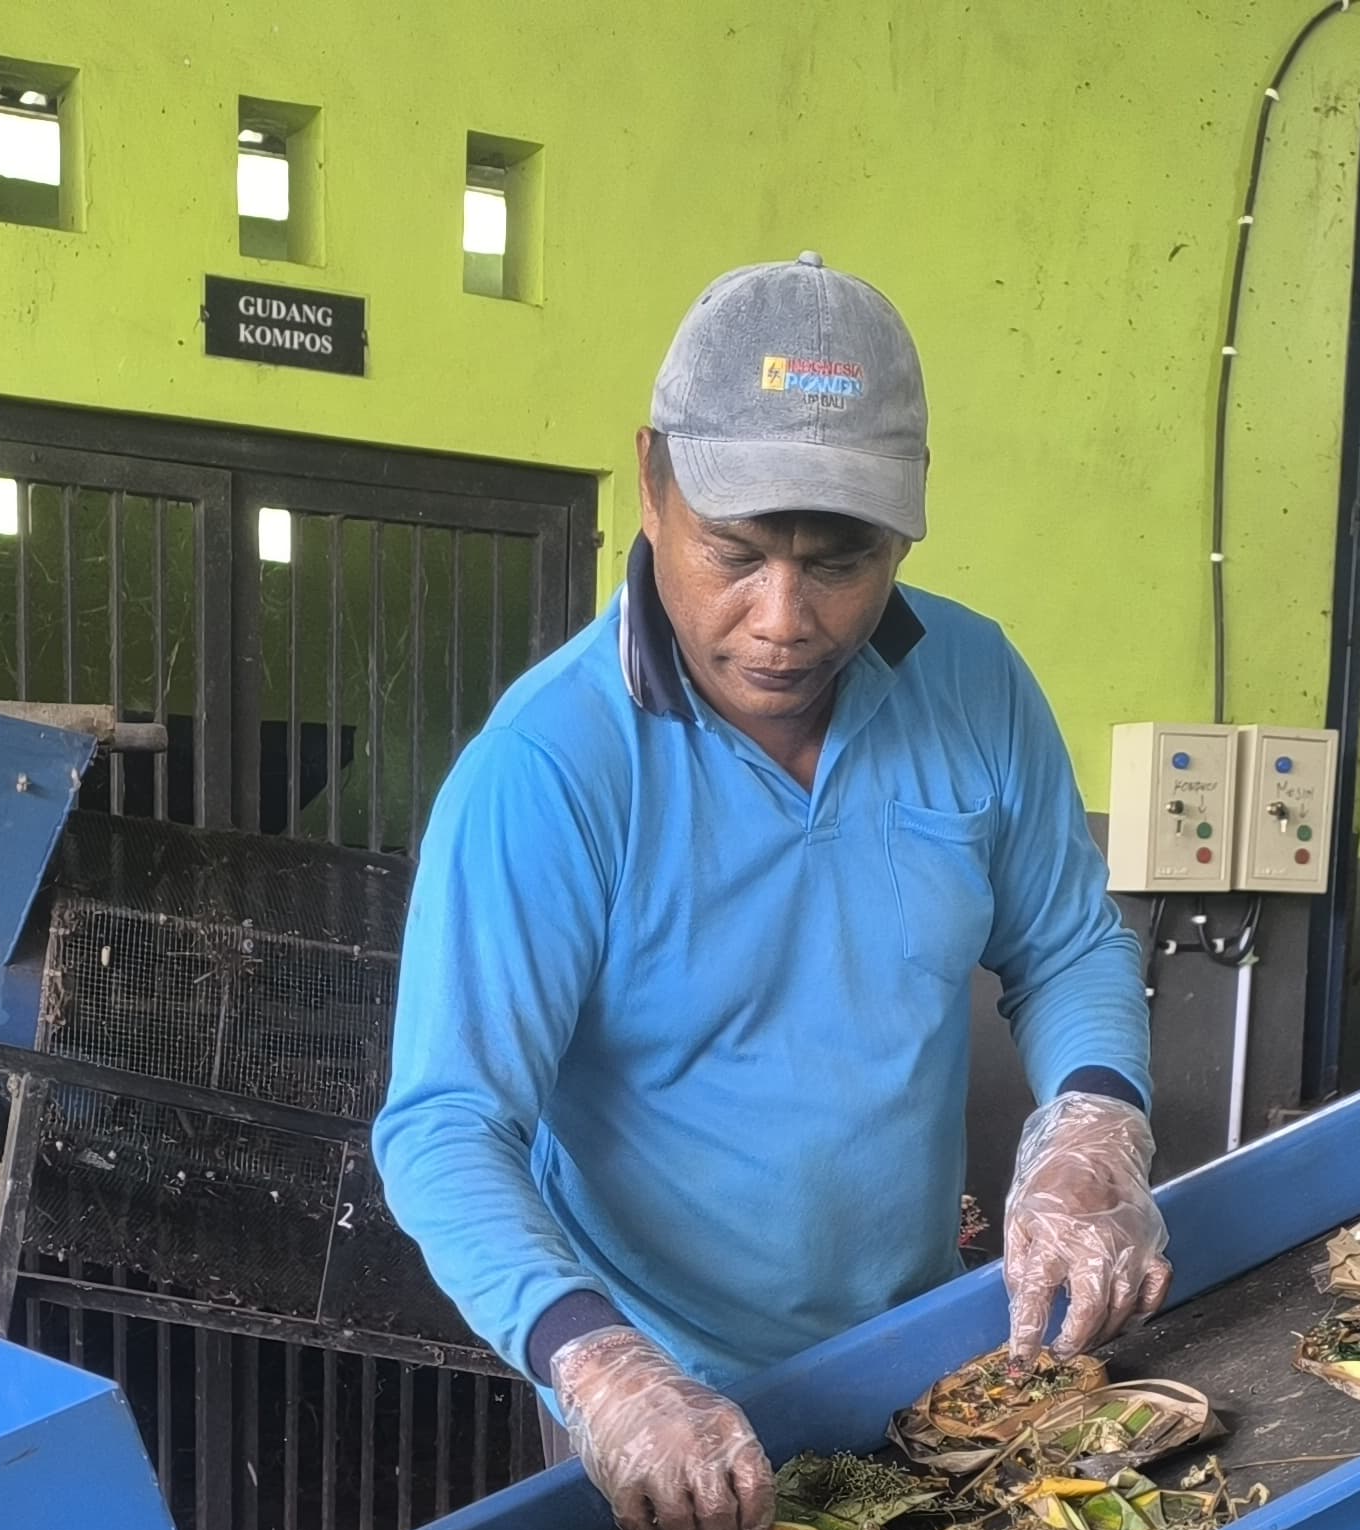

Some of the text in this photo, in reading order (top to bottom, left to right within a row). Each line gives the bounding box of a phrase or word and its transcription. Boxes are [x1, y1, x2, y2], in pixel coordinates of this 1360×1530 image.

[238, 295, 333, 327] GUDANG
[238, 322, 333, 355] KOMPOS
[787, 358, 865, 379] INDONESIA
[337, 1202, 354, 1229] 2
